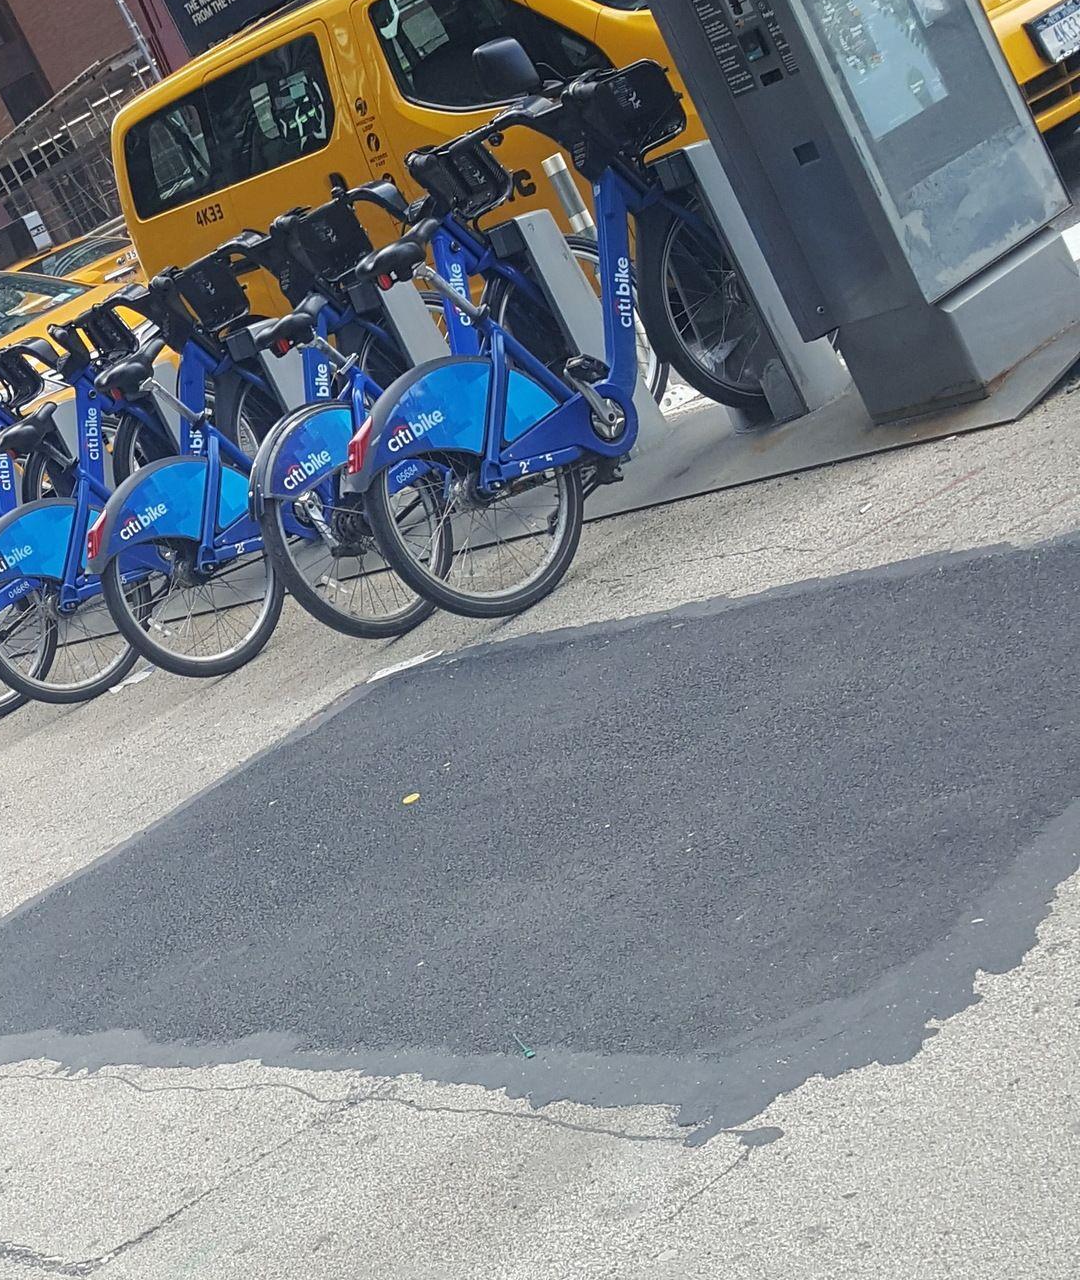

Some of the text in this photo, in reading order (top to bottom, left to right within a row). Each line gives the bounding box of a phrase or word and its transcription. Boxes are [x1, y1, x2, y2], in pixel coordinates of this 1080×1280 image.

[184, 0, 199, 15] THE
[192, 6, 216, 27] FROM
[195, 203, 224, 227] 4K33
